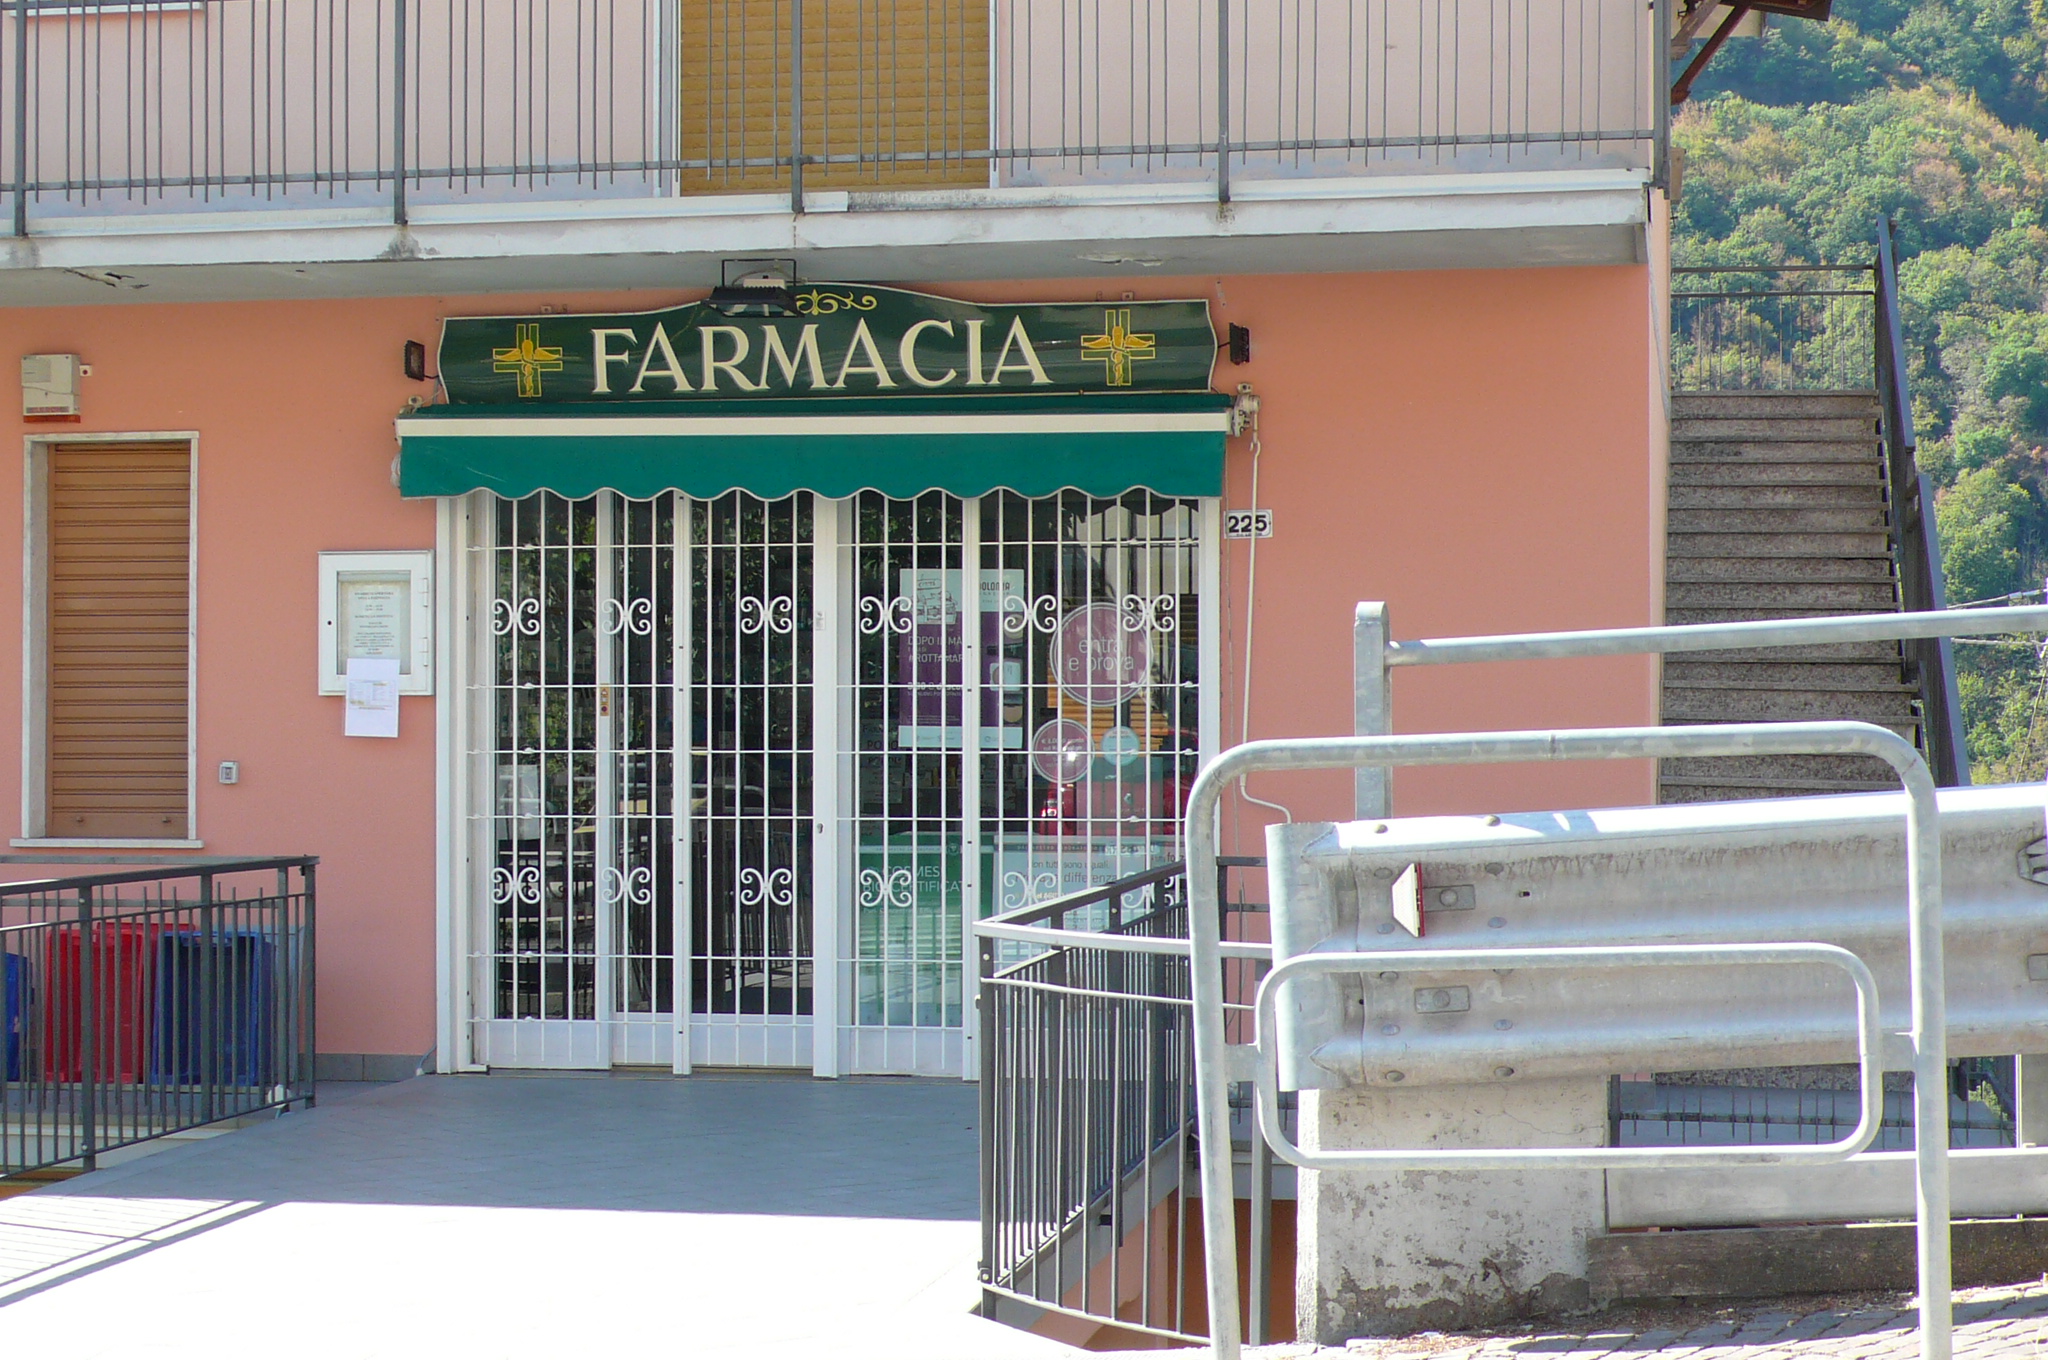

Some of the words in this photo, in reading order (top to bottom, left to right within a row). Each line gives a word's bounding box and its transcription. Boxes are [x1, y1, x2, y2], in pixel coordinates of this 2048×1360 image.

[590, 314, 1053, 394] FARMACIA
[1228, 514, 1267, 533] 225
[1064, 871, 1117, 883] diffeenza
